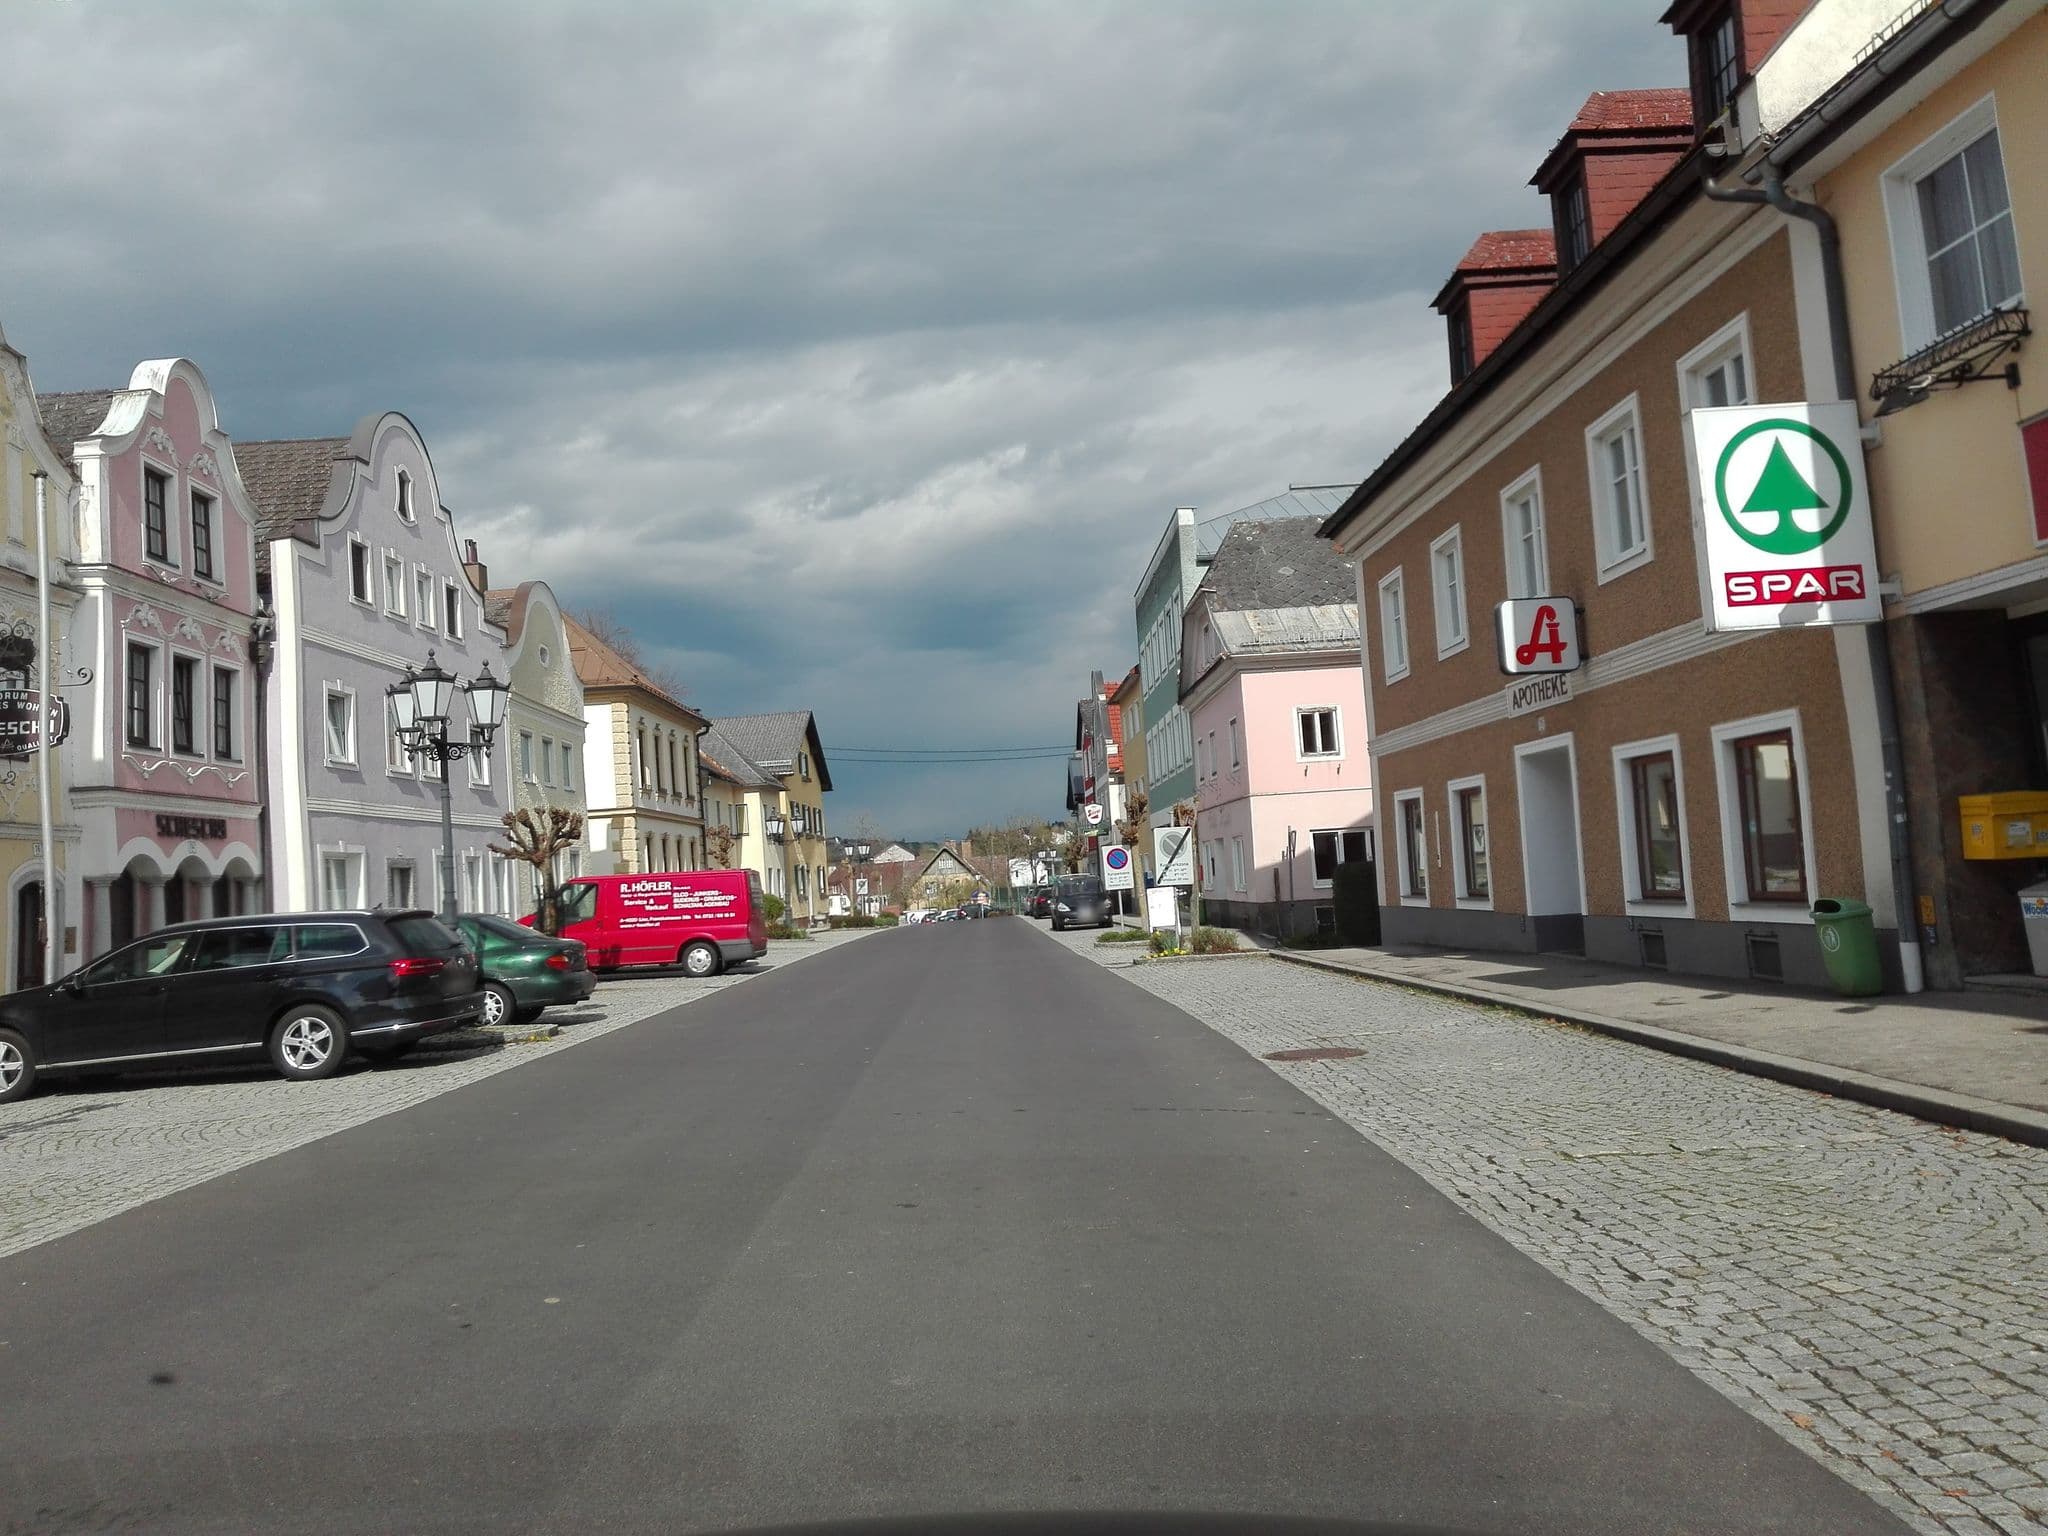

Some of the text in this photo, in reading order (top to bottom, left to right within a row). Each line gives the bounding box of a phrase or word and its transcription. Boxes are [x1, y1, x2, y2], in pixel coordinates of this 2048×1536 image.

[1728, 570, 1861, 602] SPAR
[1512, 673, 1568, 710] APOTHEKE
[620, 880, 671, 893] R. HÖFLER
